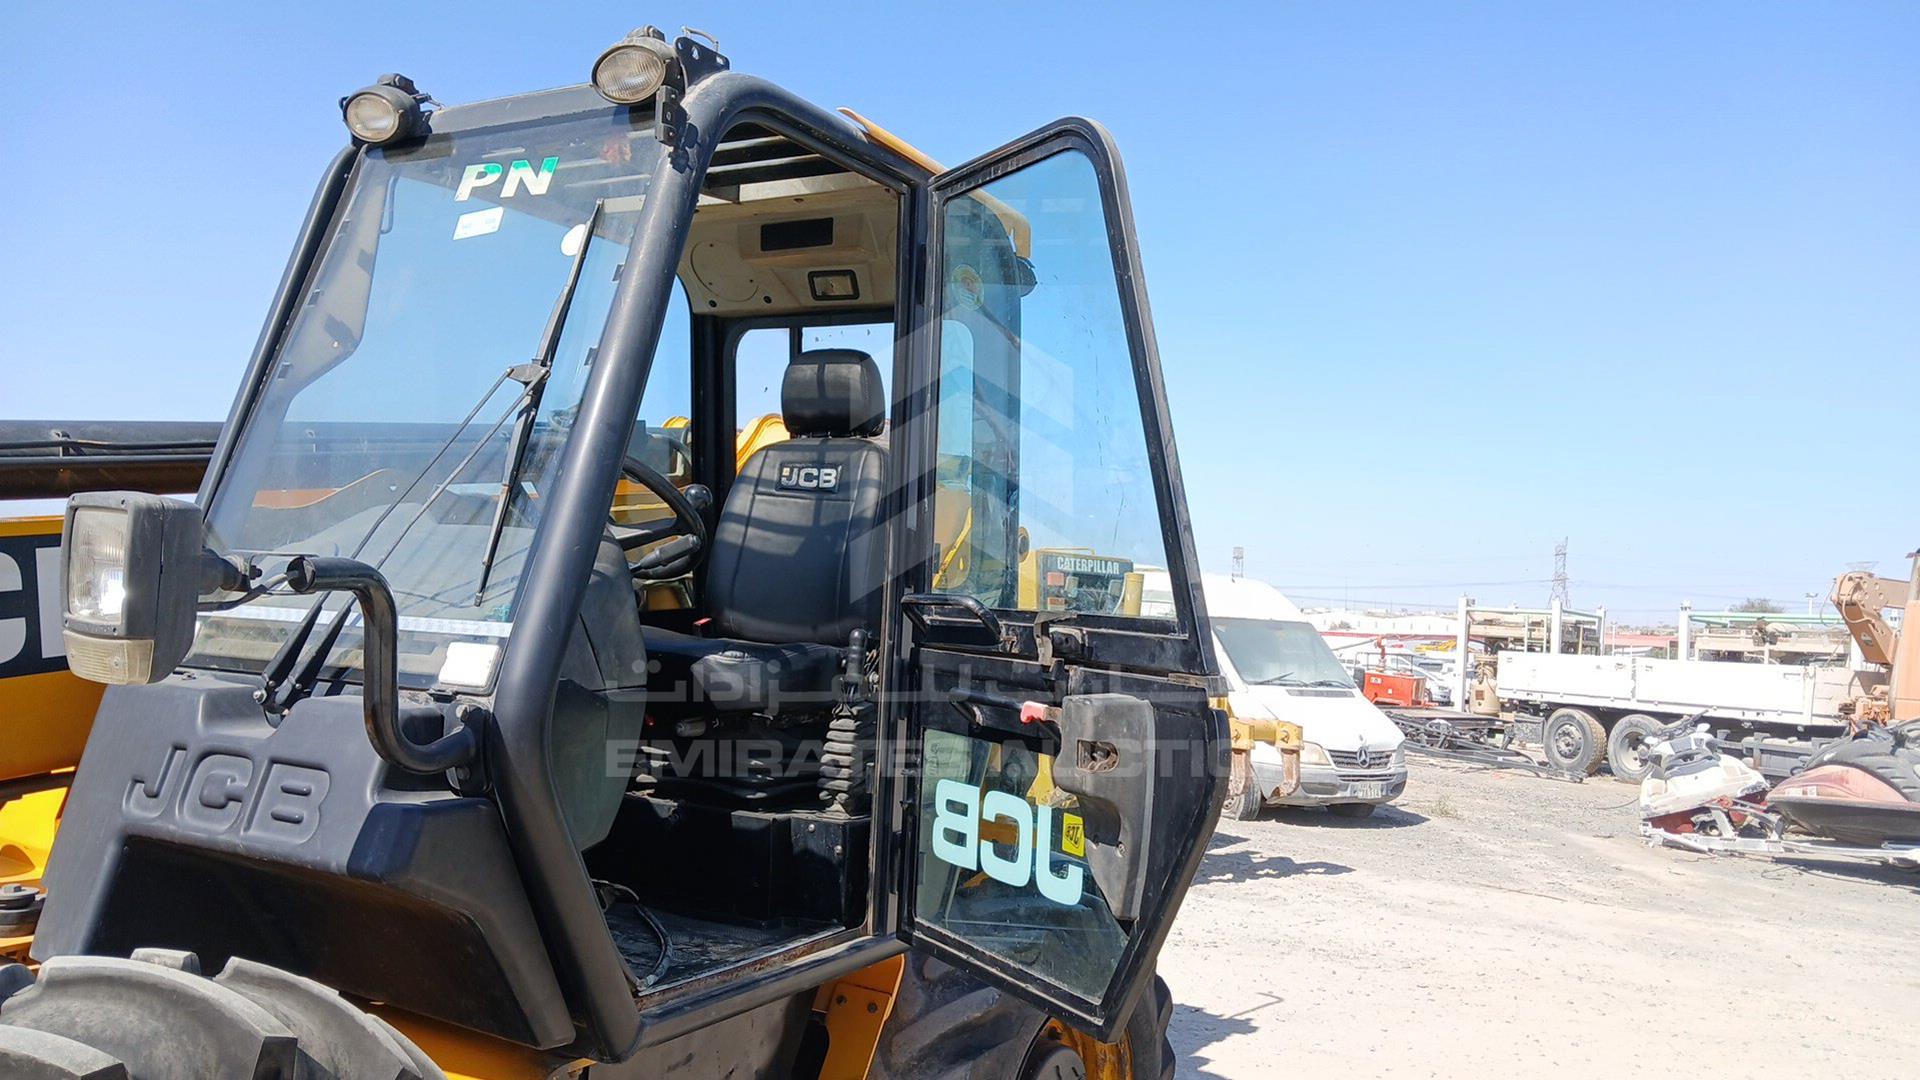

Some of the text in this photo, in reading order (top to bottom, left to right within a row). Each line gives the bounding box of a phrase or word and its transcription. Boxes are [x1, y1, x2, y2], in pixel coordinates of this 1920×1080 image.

[454, 157, 559, 202] PN
[781, 466, 838, 488] JCB
[1057, 556, 1120, 575] CATERPILLAR
[124, 743, 329, 844] JCB
